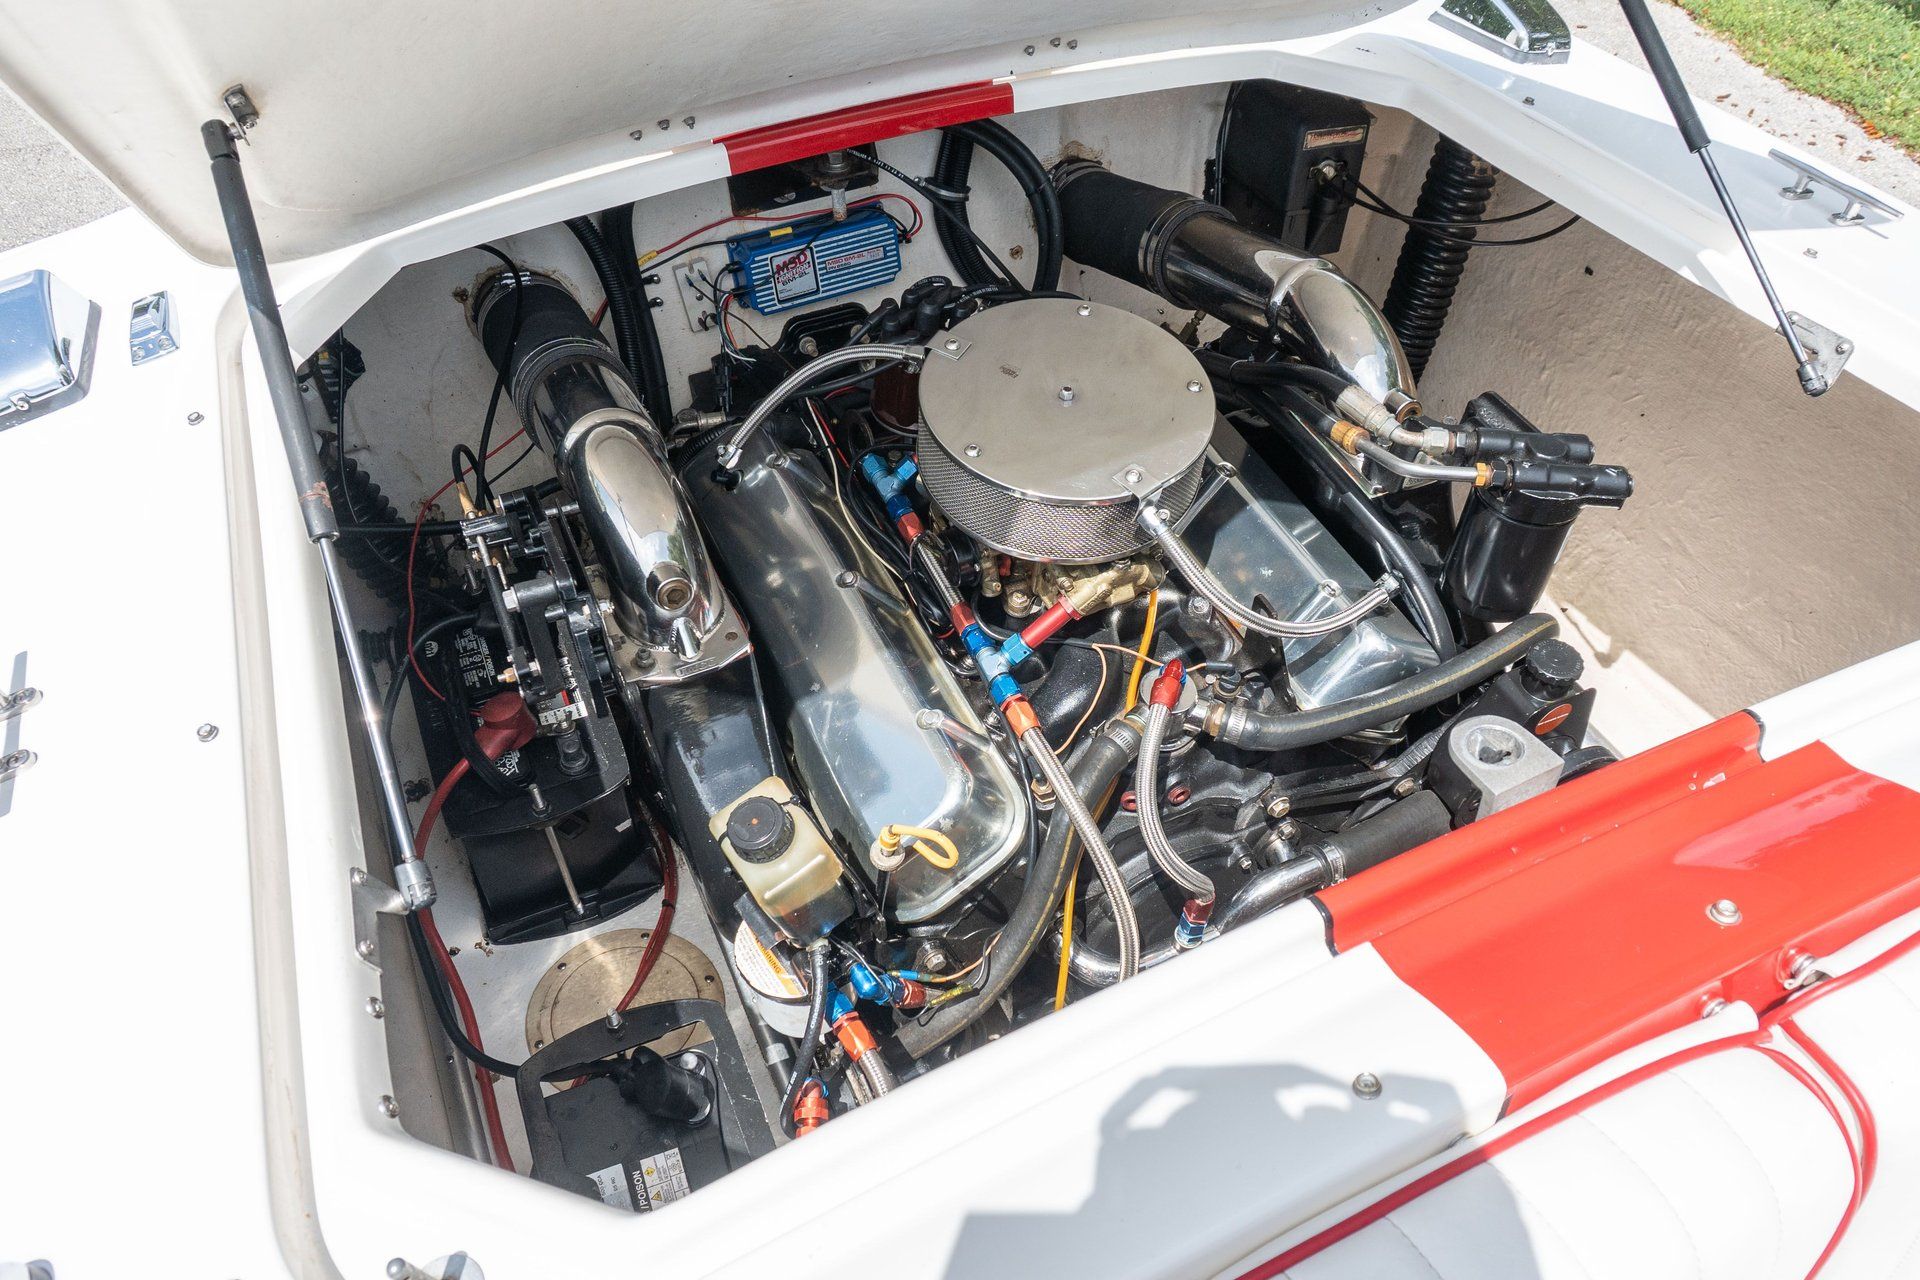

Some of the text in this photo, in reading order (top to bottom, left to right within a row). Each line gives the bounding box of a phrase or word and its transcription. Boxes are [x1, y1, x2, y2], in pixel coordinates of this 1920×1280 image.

[775, 250, 808, 276] MSD
[778, 262, 811, 284] IGNITION
[828, 258, 844, 266] MSD
[480, 636, 490, 656] DANGER
[486, 658, 496, 677] POISON
[632, 1170, 648, 1206] POISON
